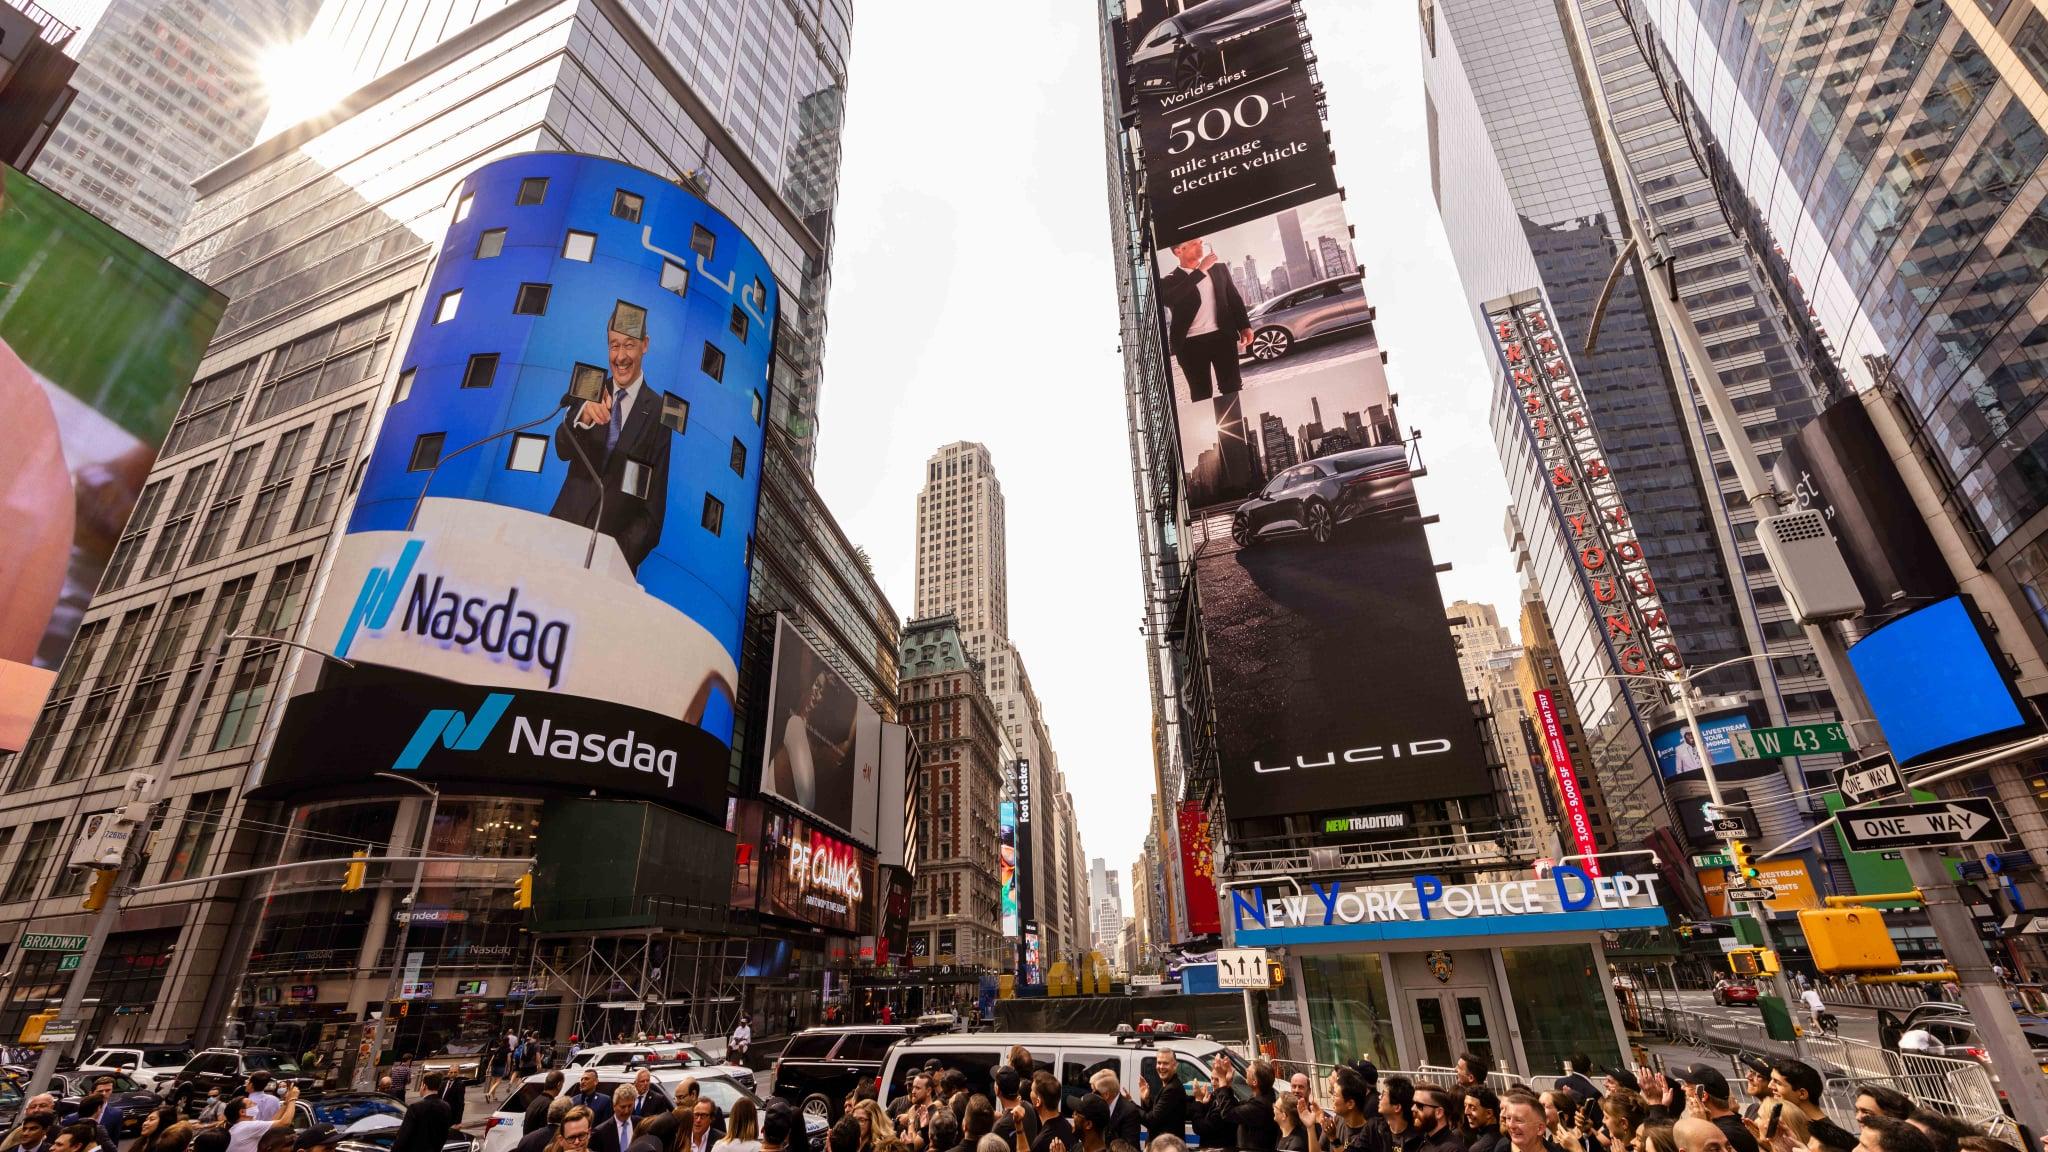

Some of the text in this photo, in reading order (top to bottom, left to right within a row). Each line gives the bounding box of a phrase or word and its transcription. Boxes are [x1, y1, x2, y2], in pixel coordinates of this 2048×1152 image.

[1160, 68, 1247, 108] World's first
[1167, 92, 1296, 155] 500+
[1170, 138, 1262, 179] mile range
[1172, 141, 1308, 195] electric vehicle
[1499, 321, 1646, 675] ERNST & YOUNG
[401, 573, 571, 690] Nasdaq
[1547, 724, 1558, 737] 212
[1702, 723, 1747, 737] LIVESTREAM
[1704, 733, 1724, 742] YOUR
[1757, 727, 1844, 754] W 43 St
[507, 715, 678, 789] Nasdaq
[1254, 738, 1452, 774] LUCID
[1560, 766, 1570, 778] SF
[1845, 767, 1890, 795] ONE WAY
[1018, 761, 1029, 823] Foot Locker
[1564, 779, 1578, 807] 9,000
[1325, 813, 1404, 833] NEWTRADITION
[1573, 813, 1589, 842] 3,000
[1863, 812, 1973, 838] ONE WAY
[1702, 858, 1711, 868] W
[1713, 856, 1723, 866] 43
[1231, 865, 1660, 930] NEW YORK POLICE DEPT
[1754, 891, 1769, 899] WAY
[25, 935, 84, 950] BROADWAY
[469, 944, 511, 956] Nasdaq
[68, 956, 79, 968] 43
[1274, 967, 1282, 982] 8
